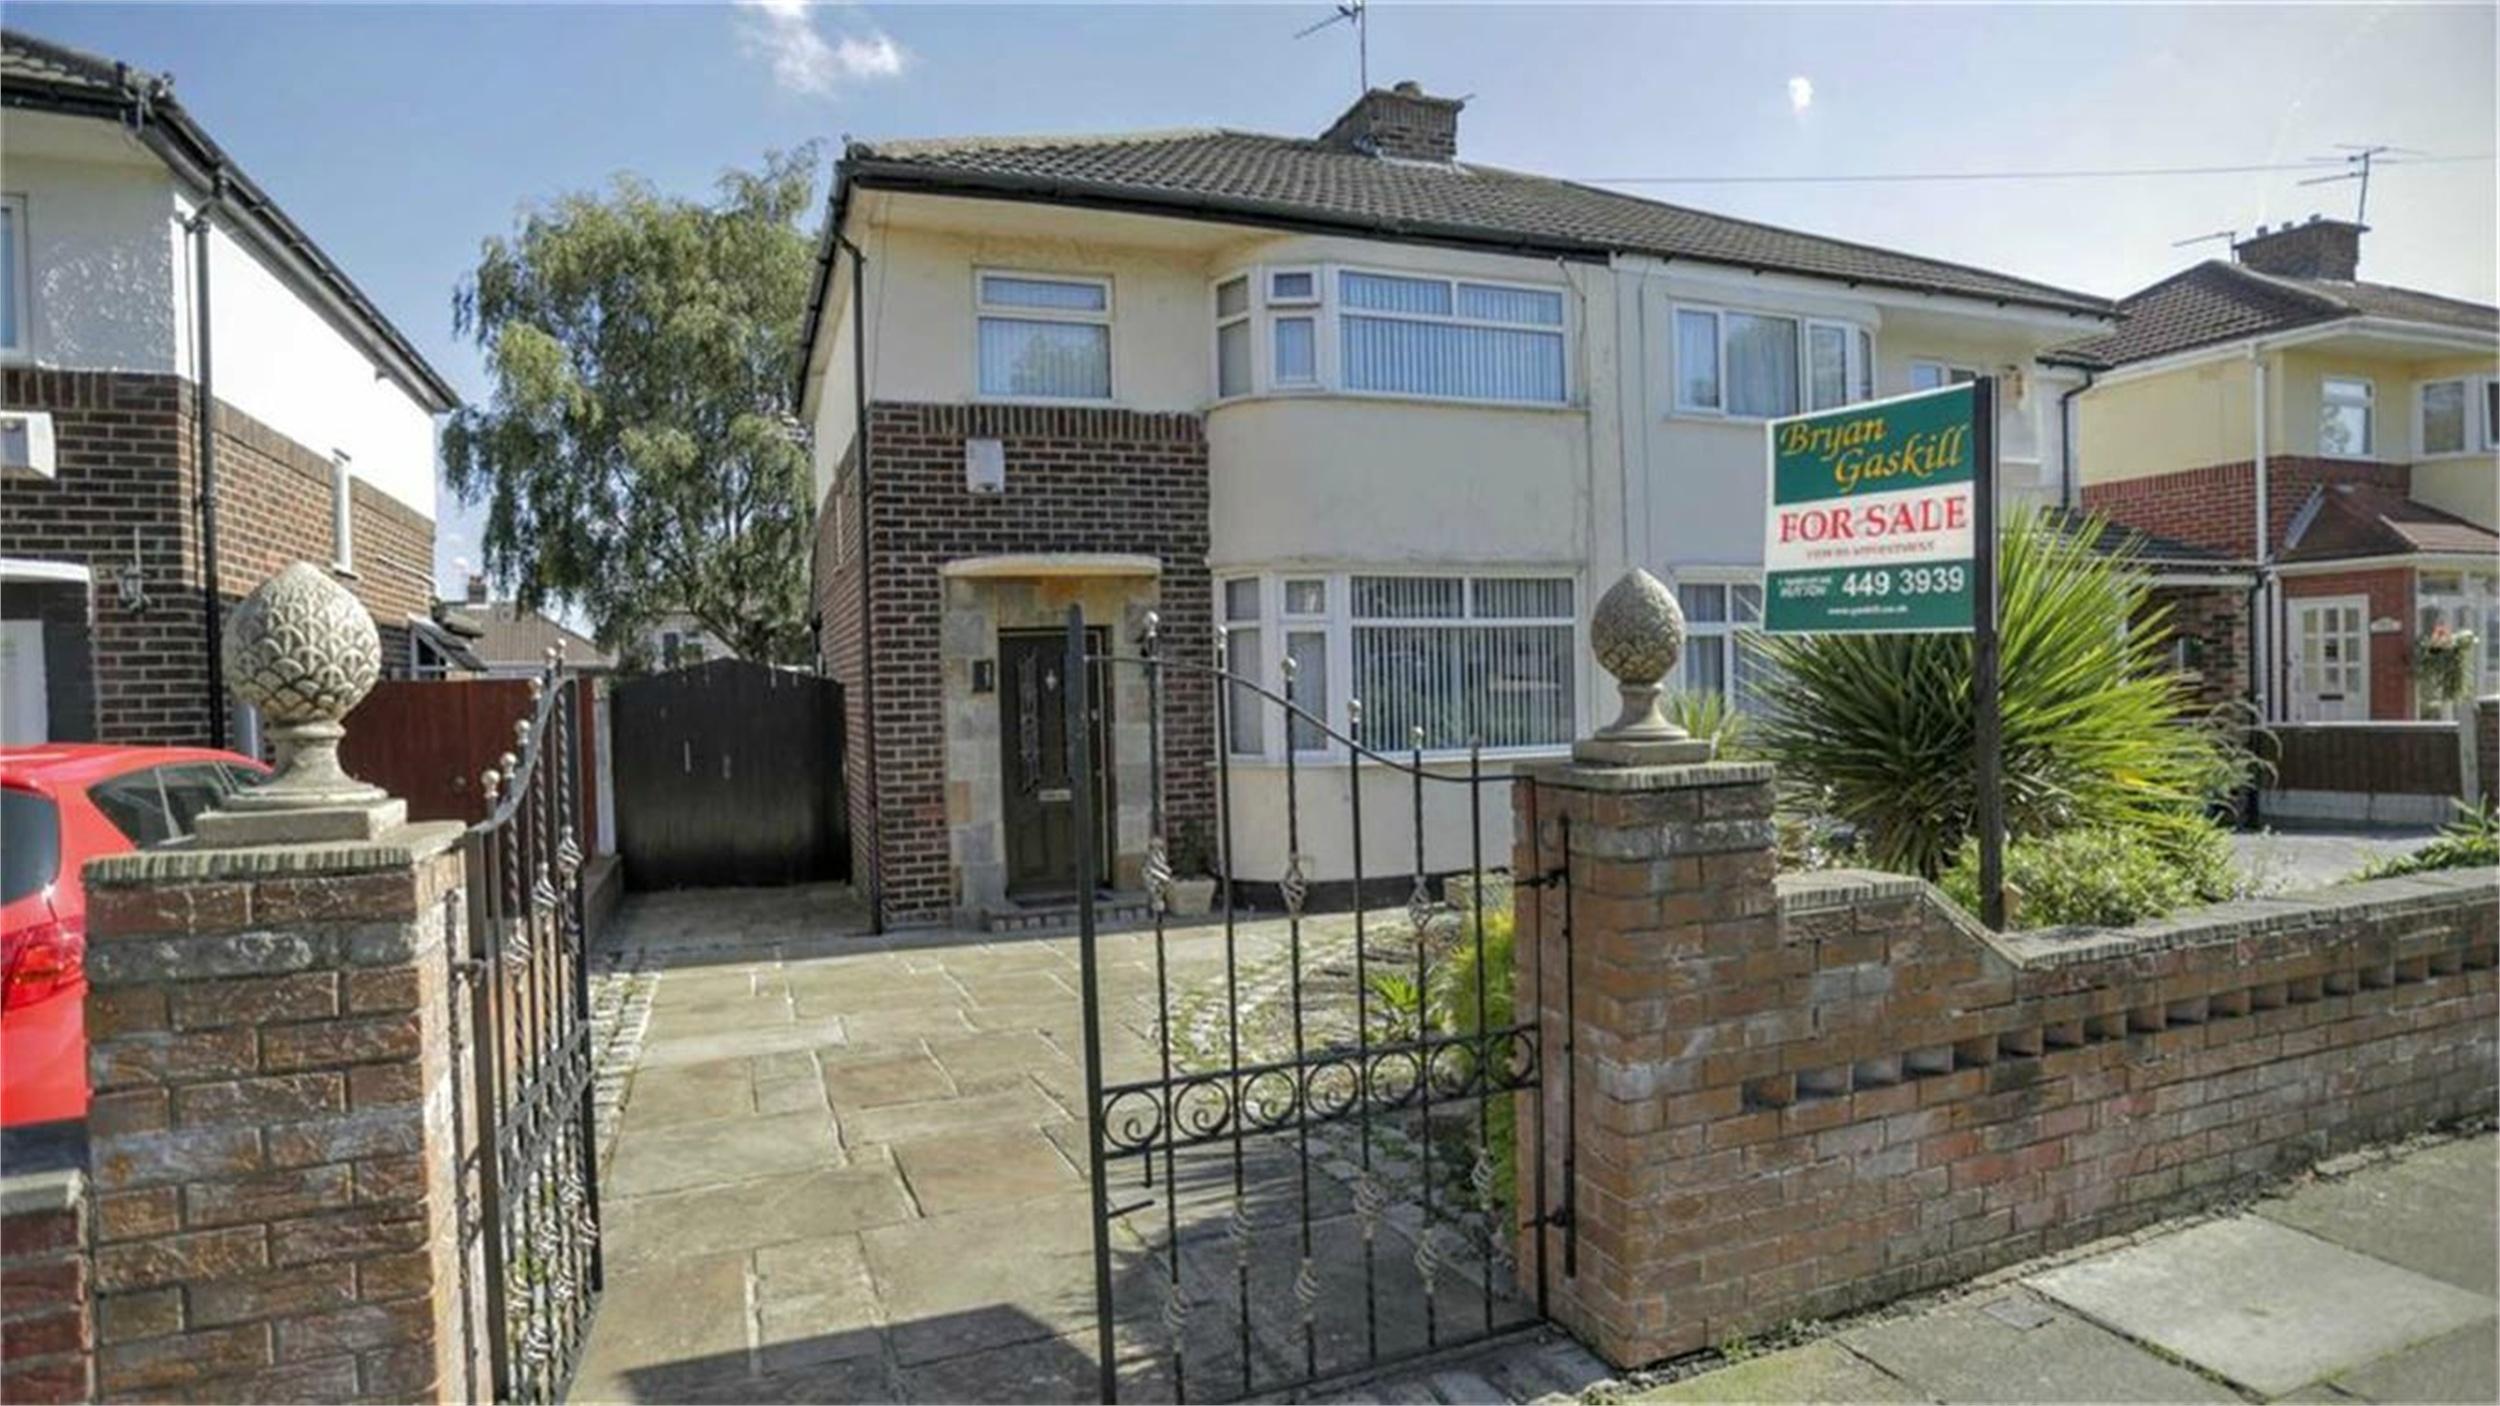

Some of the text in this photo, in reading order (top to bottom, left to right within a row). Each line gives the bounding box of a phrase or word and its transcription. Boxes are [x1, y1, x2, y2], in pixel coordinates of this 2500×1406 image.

[1780, 418, 1885, 461] Bryan
[1835, 424, 1968, 493] Gaskill
[1780, 496, 1967, 543] FOR SALE
[1842, 571, 1890, 596] 449
[1898, 566, 1965, 595] 3939
